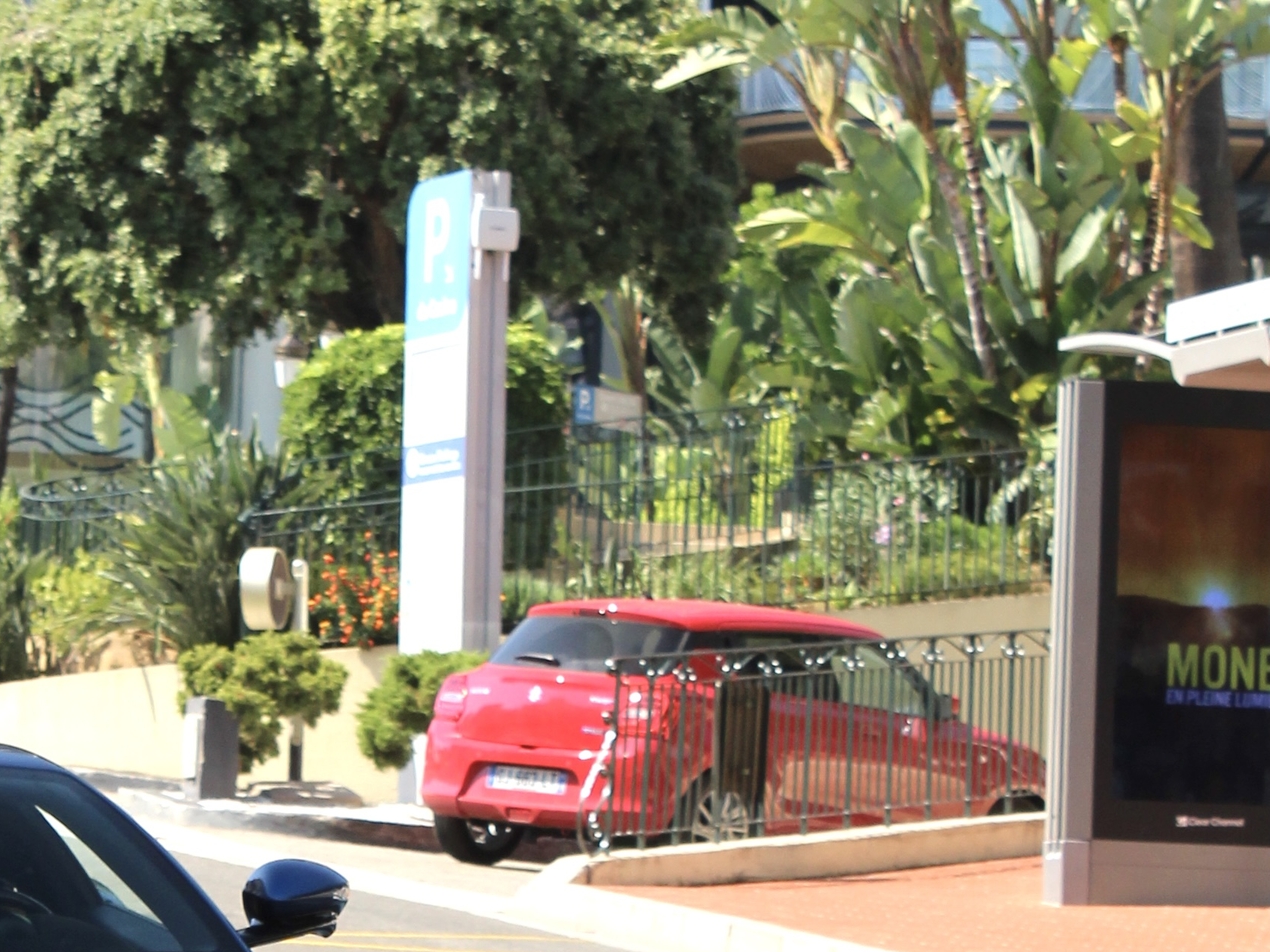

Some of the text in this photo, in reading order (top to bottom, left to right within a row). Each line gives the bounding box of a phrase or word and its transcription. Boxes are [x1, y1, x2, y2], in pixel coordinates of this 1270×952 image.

[424, 198, 450, 283] P
[579, 389, 591, 410] P
[1166, 689, 1184, 704] EN
[1186, 690, 1231, 707] PLEINE
